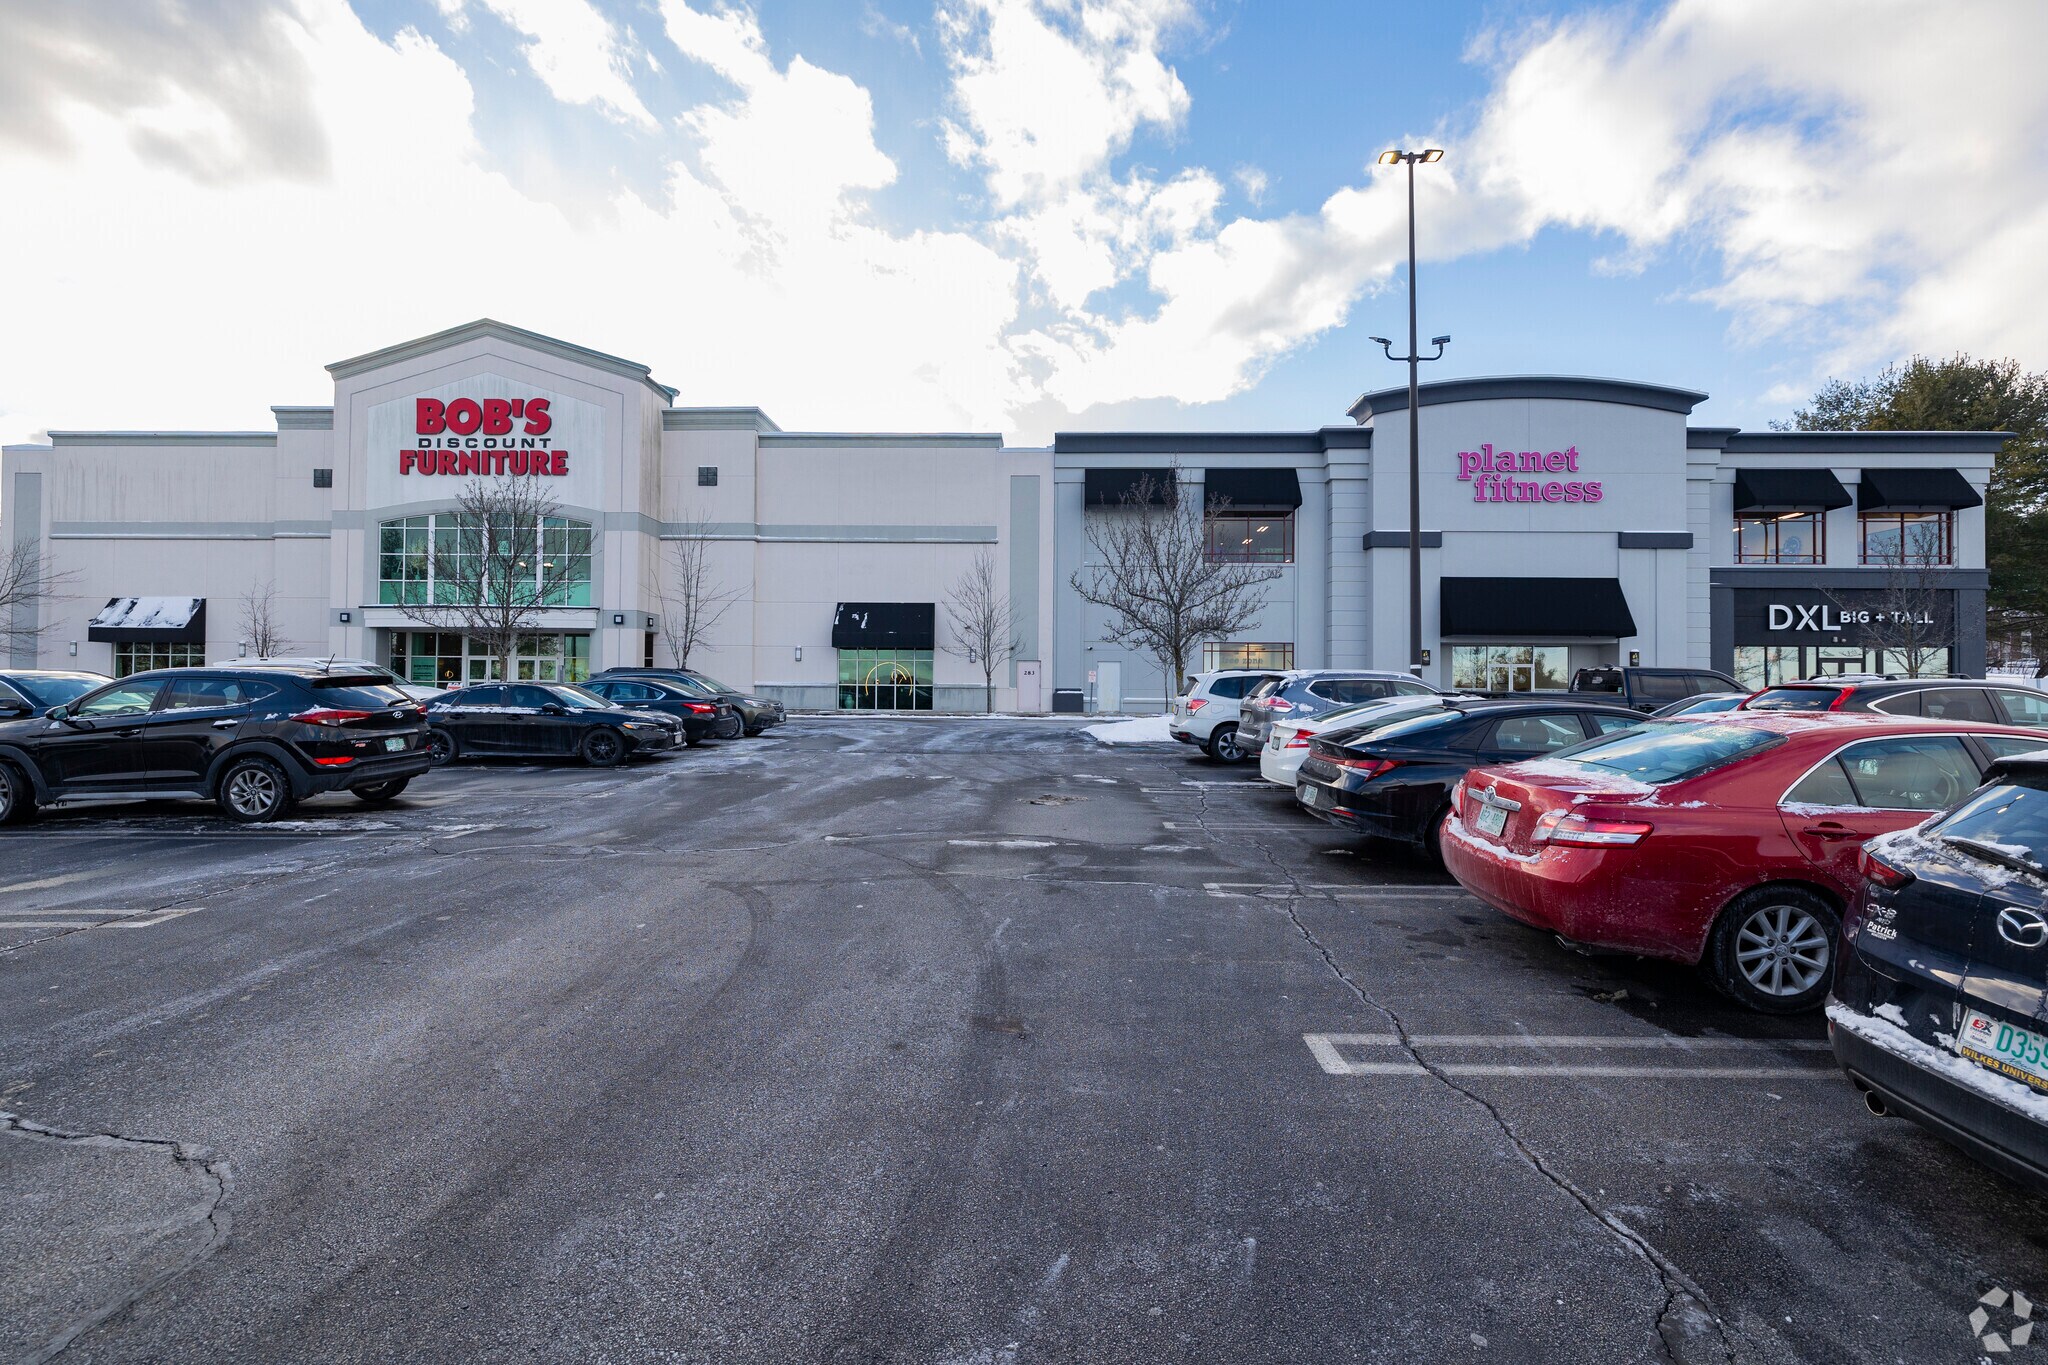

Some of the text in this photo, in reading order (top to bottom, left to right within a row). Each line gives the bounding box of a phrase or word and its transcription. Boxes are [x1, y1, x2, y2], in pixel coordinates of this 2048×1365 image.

[416, 397, 552, 436] BOB'S
[418, 438, 552, 448] DISCOUNT
[400, 449, 569, 476] FURNITURE
[1457, 443, 1580, 481] planet
[1474, 473, 1604, 503] fitness
[1768, 604, 1934, 631] DXL BIG + TALL
[1242, 657, 1264, 665] zone
[1867, 921, 1898, 938] Patrick
[1962, 1047, 2000, 1068] WILKES
